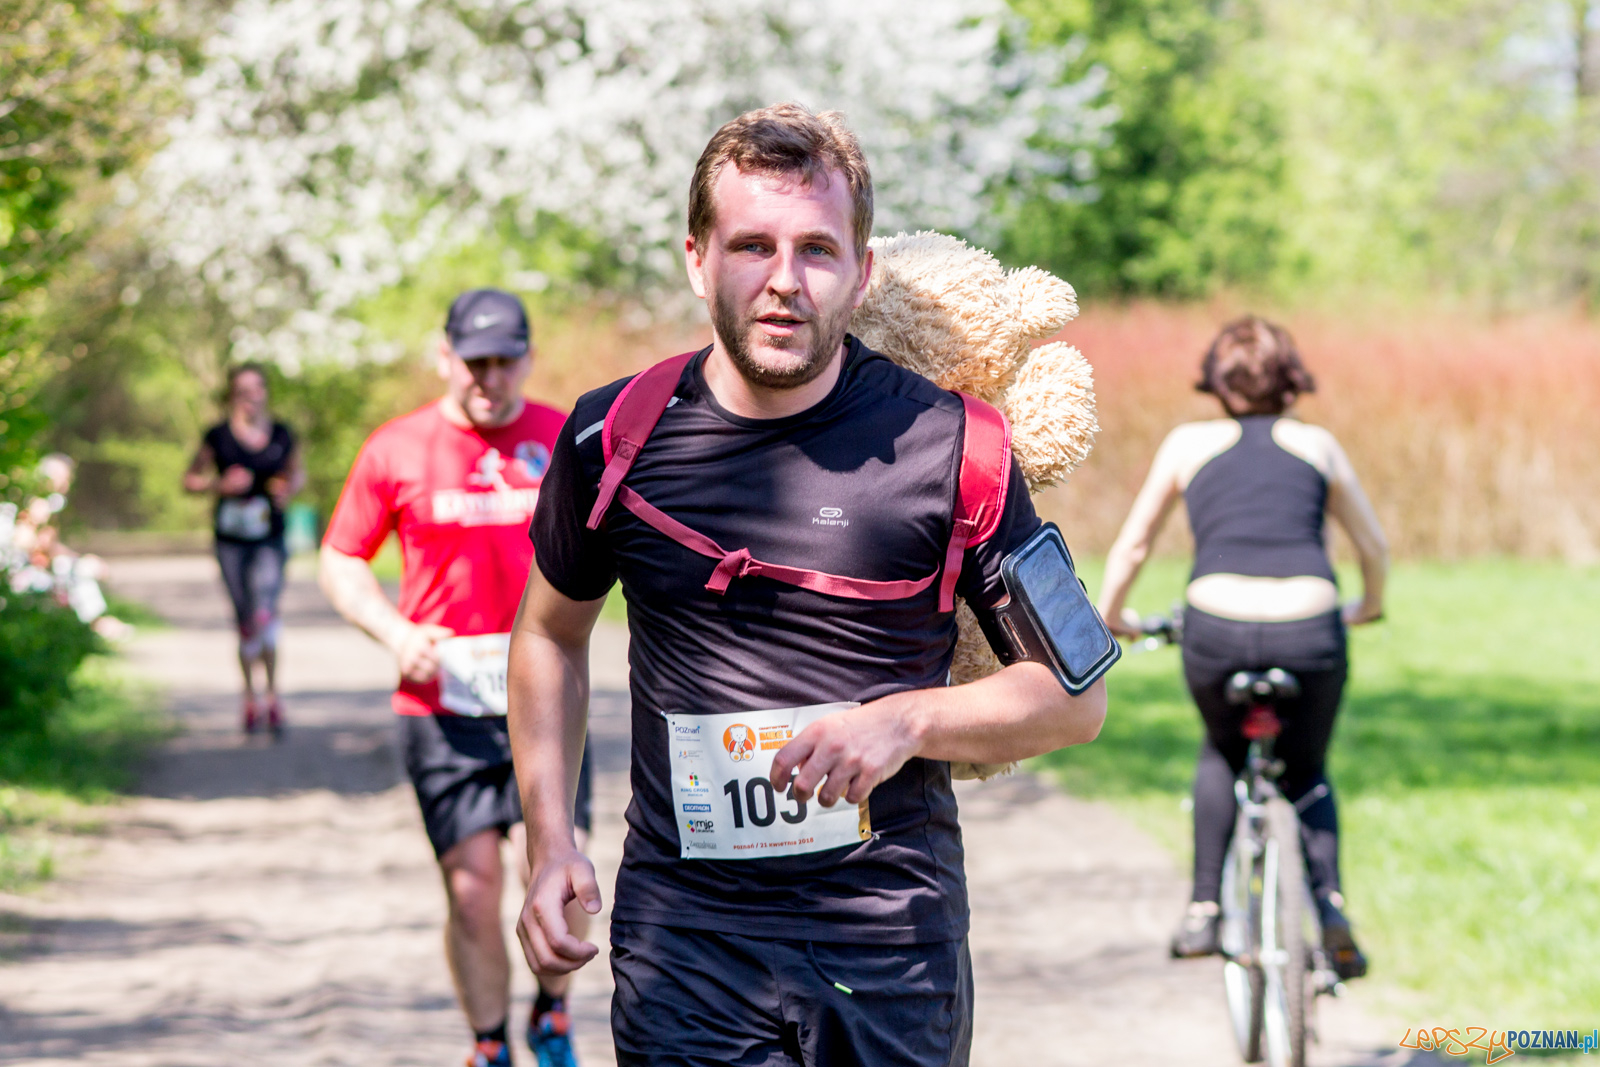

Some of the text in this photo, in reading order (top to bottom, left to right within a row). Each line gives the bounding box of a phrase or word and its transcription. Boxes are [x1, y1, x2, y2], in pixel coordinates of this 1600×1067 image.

[812, 517, 849, 528] Kalenji
[724, 774, 808, 828] 103
[798, 837, 814, 846] 2018
